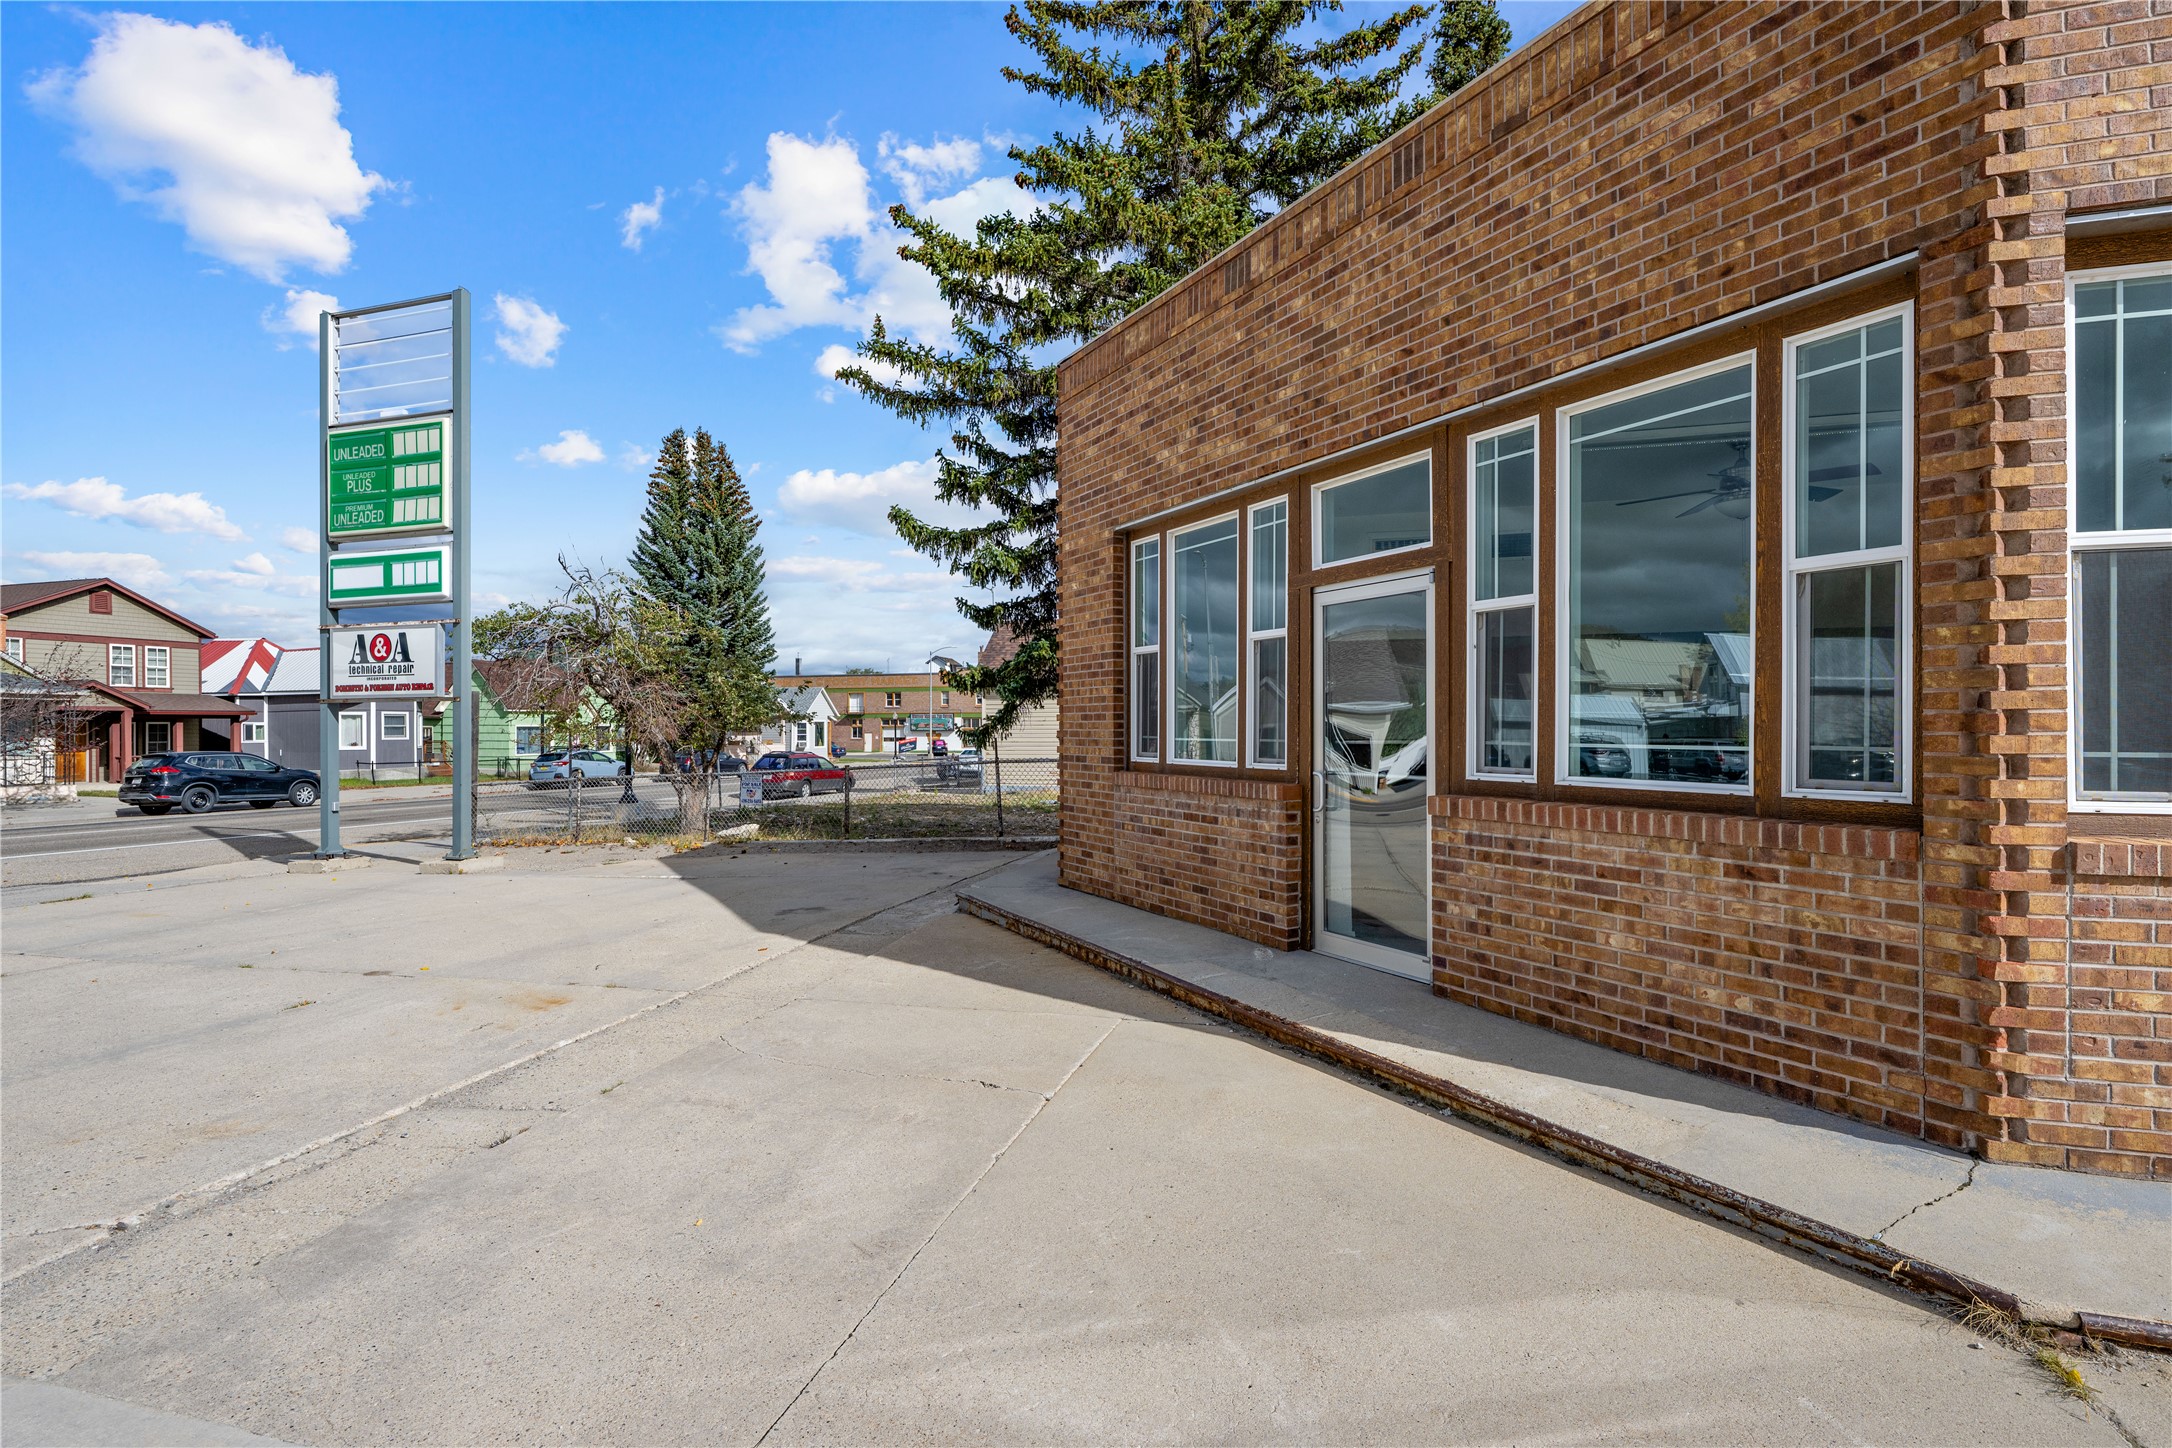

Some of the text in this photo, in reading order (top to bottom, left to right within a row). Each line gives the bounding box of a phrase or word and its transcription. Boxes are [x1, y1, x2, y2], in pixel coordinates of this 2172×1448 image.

[333, 443, 385, 461] UNLEADED
[342, 471, 376, 480] UNLEADED
[347, 479, 372, 493] PLUS
[345, 504, 374, 512] PREMIUM
[333, 509, 385, 527] UNLEADED
[348, 663, 415, 675] technical repair
[335, 684, 364, 693] DOMESTIC
[369, 683, 395, 692] FOREIGN
[395, 683, 411, 691] AUTO
[411, 682, 435, 691] REPAIR
